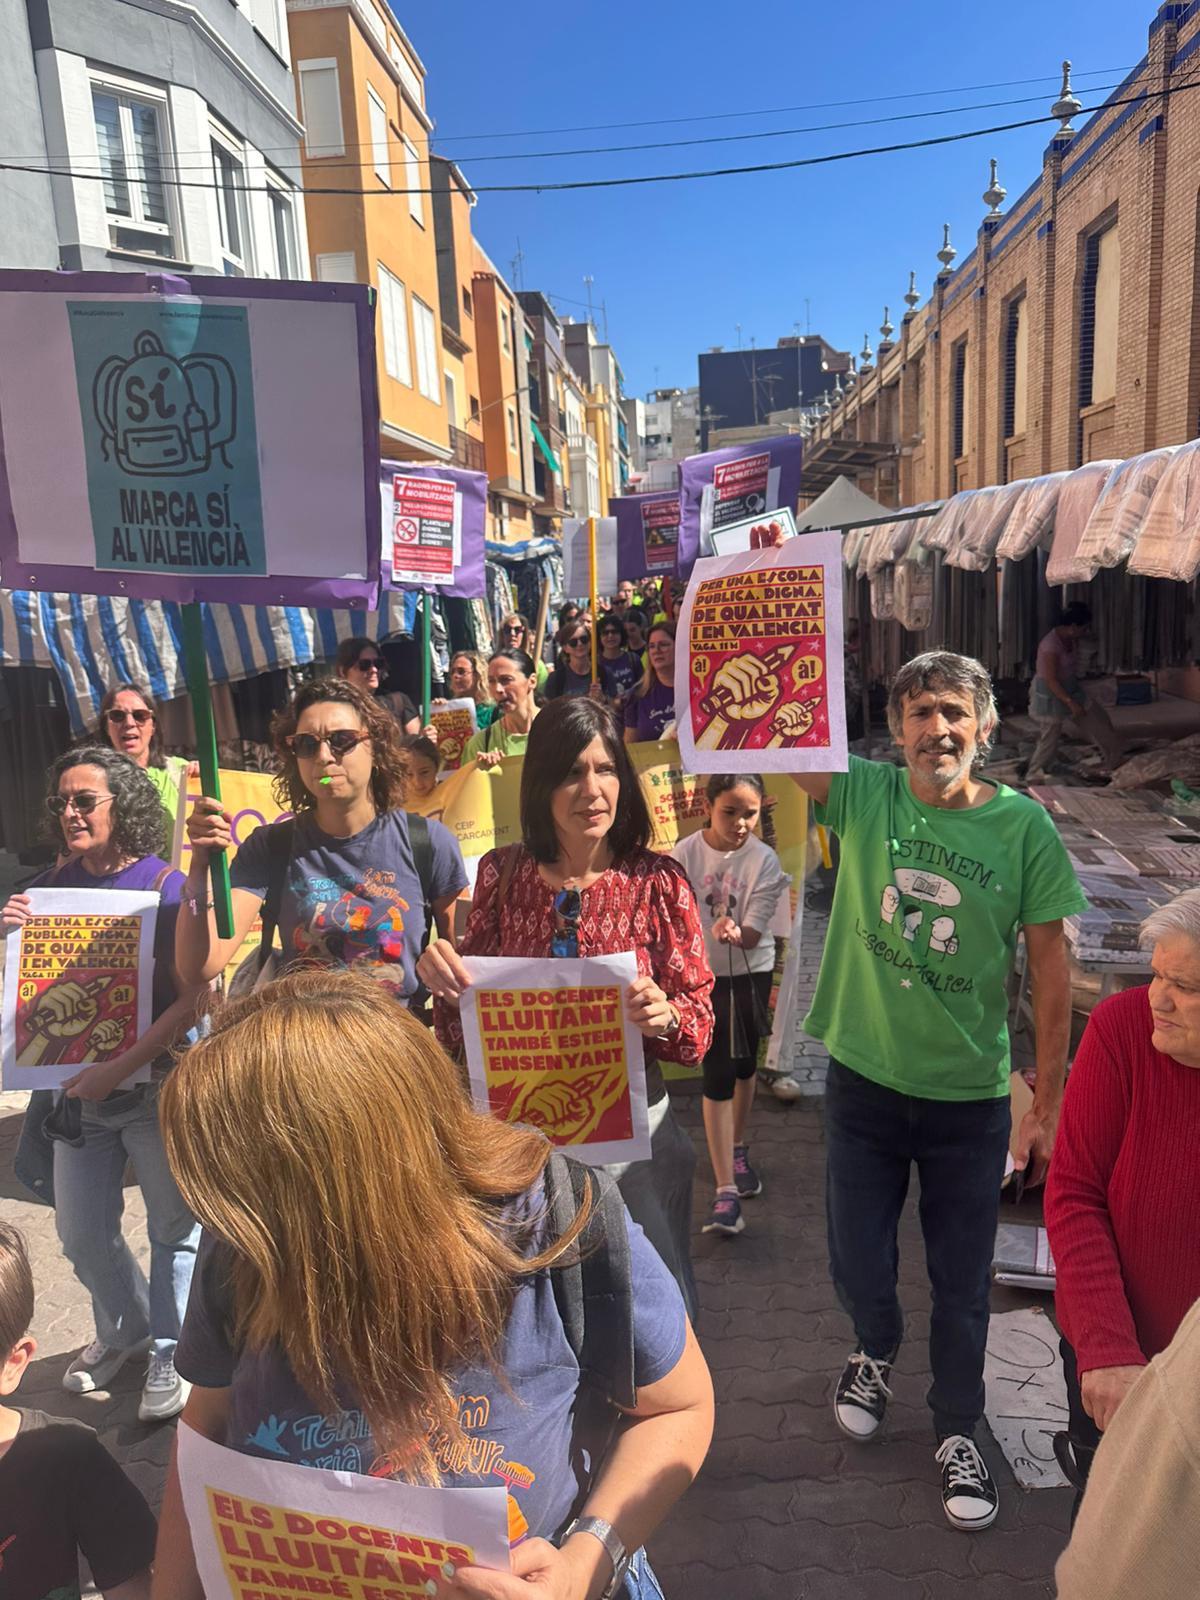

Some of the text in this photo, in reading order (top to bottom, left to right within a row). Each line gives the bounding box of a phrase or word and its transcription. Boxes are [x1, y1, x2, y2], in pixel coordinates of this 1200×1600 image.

[717, 469, 726, 484] 7
[396, 480, 407, 496] 7
[119, 483, 231, 528] MARCA SÍ
[111, 523, 251, 567] AL VALENCIÀ
[700, 569, 821, 592] PER UNA ESCOLA
[693, 601, 822, 623] DE QUALITAT
[692, 626, 698, 639] I
[702, 625, 725, 638] EN
[692, 643, 717, 651] VAGA
[694, 658, 707, 673] à!
[798, 660, 816, 679] à!
[454, 820, 475, 832] CEIP
[456, 825, 510, 842] CARCAIXENT
[25, 918, 138, 927] PER UNA ESCOLA
[23, 943, 137, 954] DE QUALITAT
[22, 958, 28, 968] I
[31, 958, 52, 968] EN
[22, 984, 33, 997] à!
[114, 989, 129, 1001] à!
[479, 988, 619, 1008] ELS DOCENTS
[481, 1003, 618, 1032] LLUITANT
[484, 1027, 622, 1051] TAMBÉ ESTEM
[489, 1047, 623, 1071] ENSENYANT
[212, 1493, 471, 1565] ELS DOCENTS
[218, 1522, 443, 1586] LLUITAN
[229, 1562, 352, 1599] TAMBÉ
